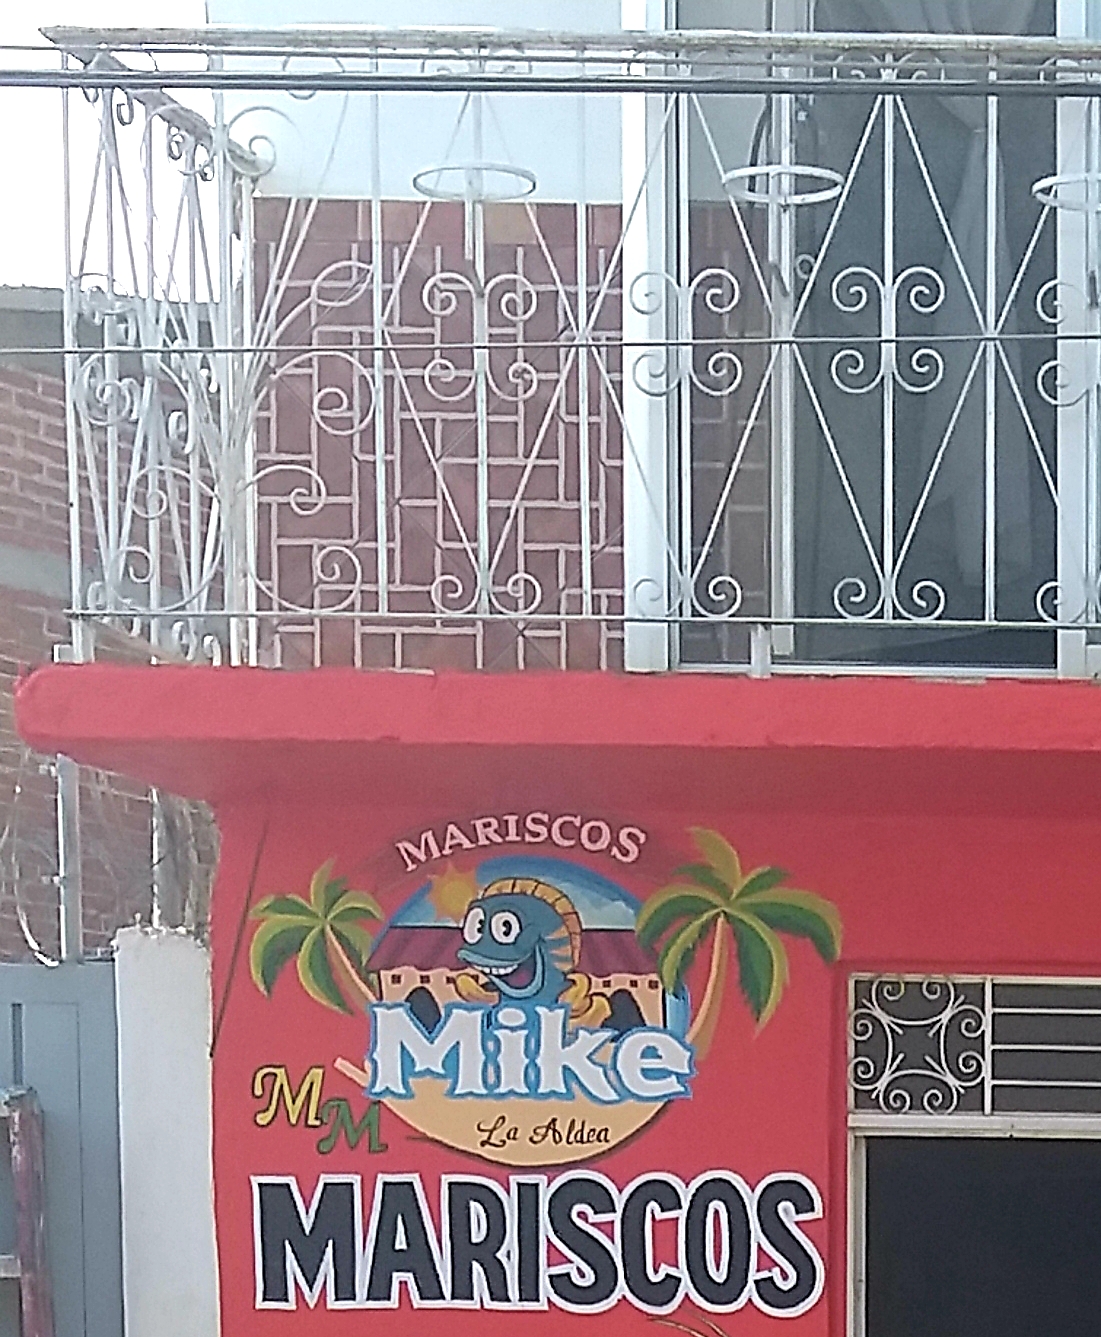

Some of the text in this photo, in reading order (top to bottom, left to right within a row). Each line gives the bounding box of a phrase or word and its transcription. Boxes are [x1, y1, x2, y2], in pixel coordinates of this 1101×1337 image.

[396, 811, 648, 872] MARISCOS
[366, 999, 697, 1101] Mike
[476, 1112, 611, 1149] La Aldea
[251, 1170, 826, 1318] MARISCOS
